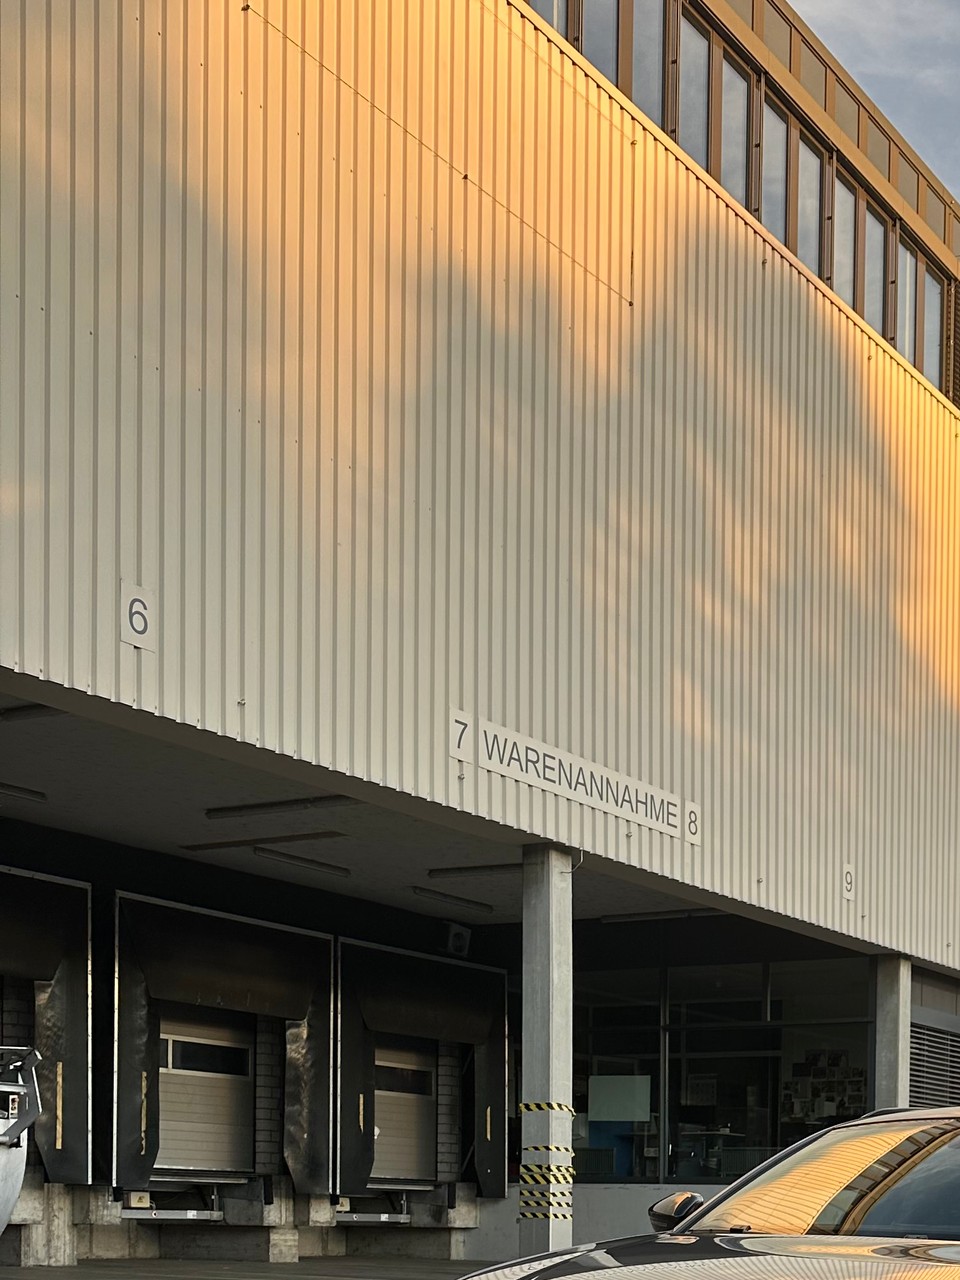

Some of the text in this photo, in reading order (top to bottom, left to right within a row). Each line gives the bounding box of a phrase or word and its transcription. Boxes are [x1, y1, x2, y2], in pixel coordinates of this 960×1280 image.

[128, 597, 148, 635] 6
[454, 718, 468, 749] 7
[483, 729, 678, 829] WARENANNAHME
[688, 809, 698, 836] 8
[845, 870, 853, 892] 9
